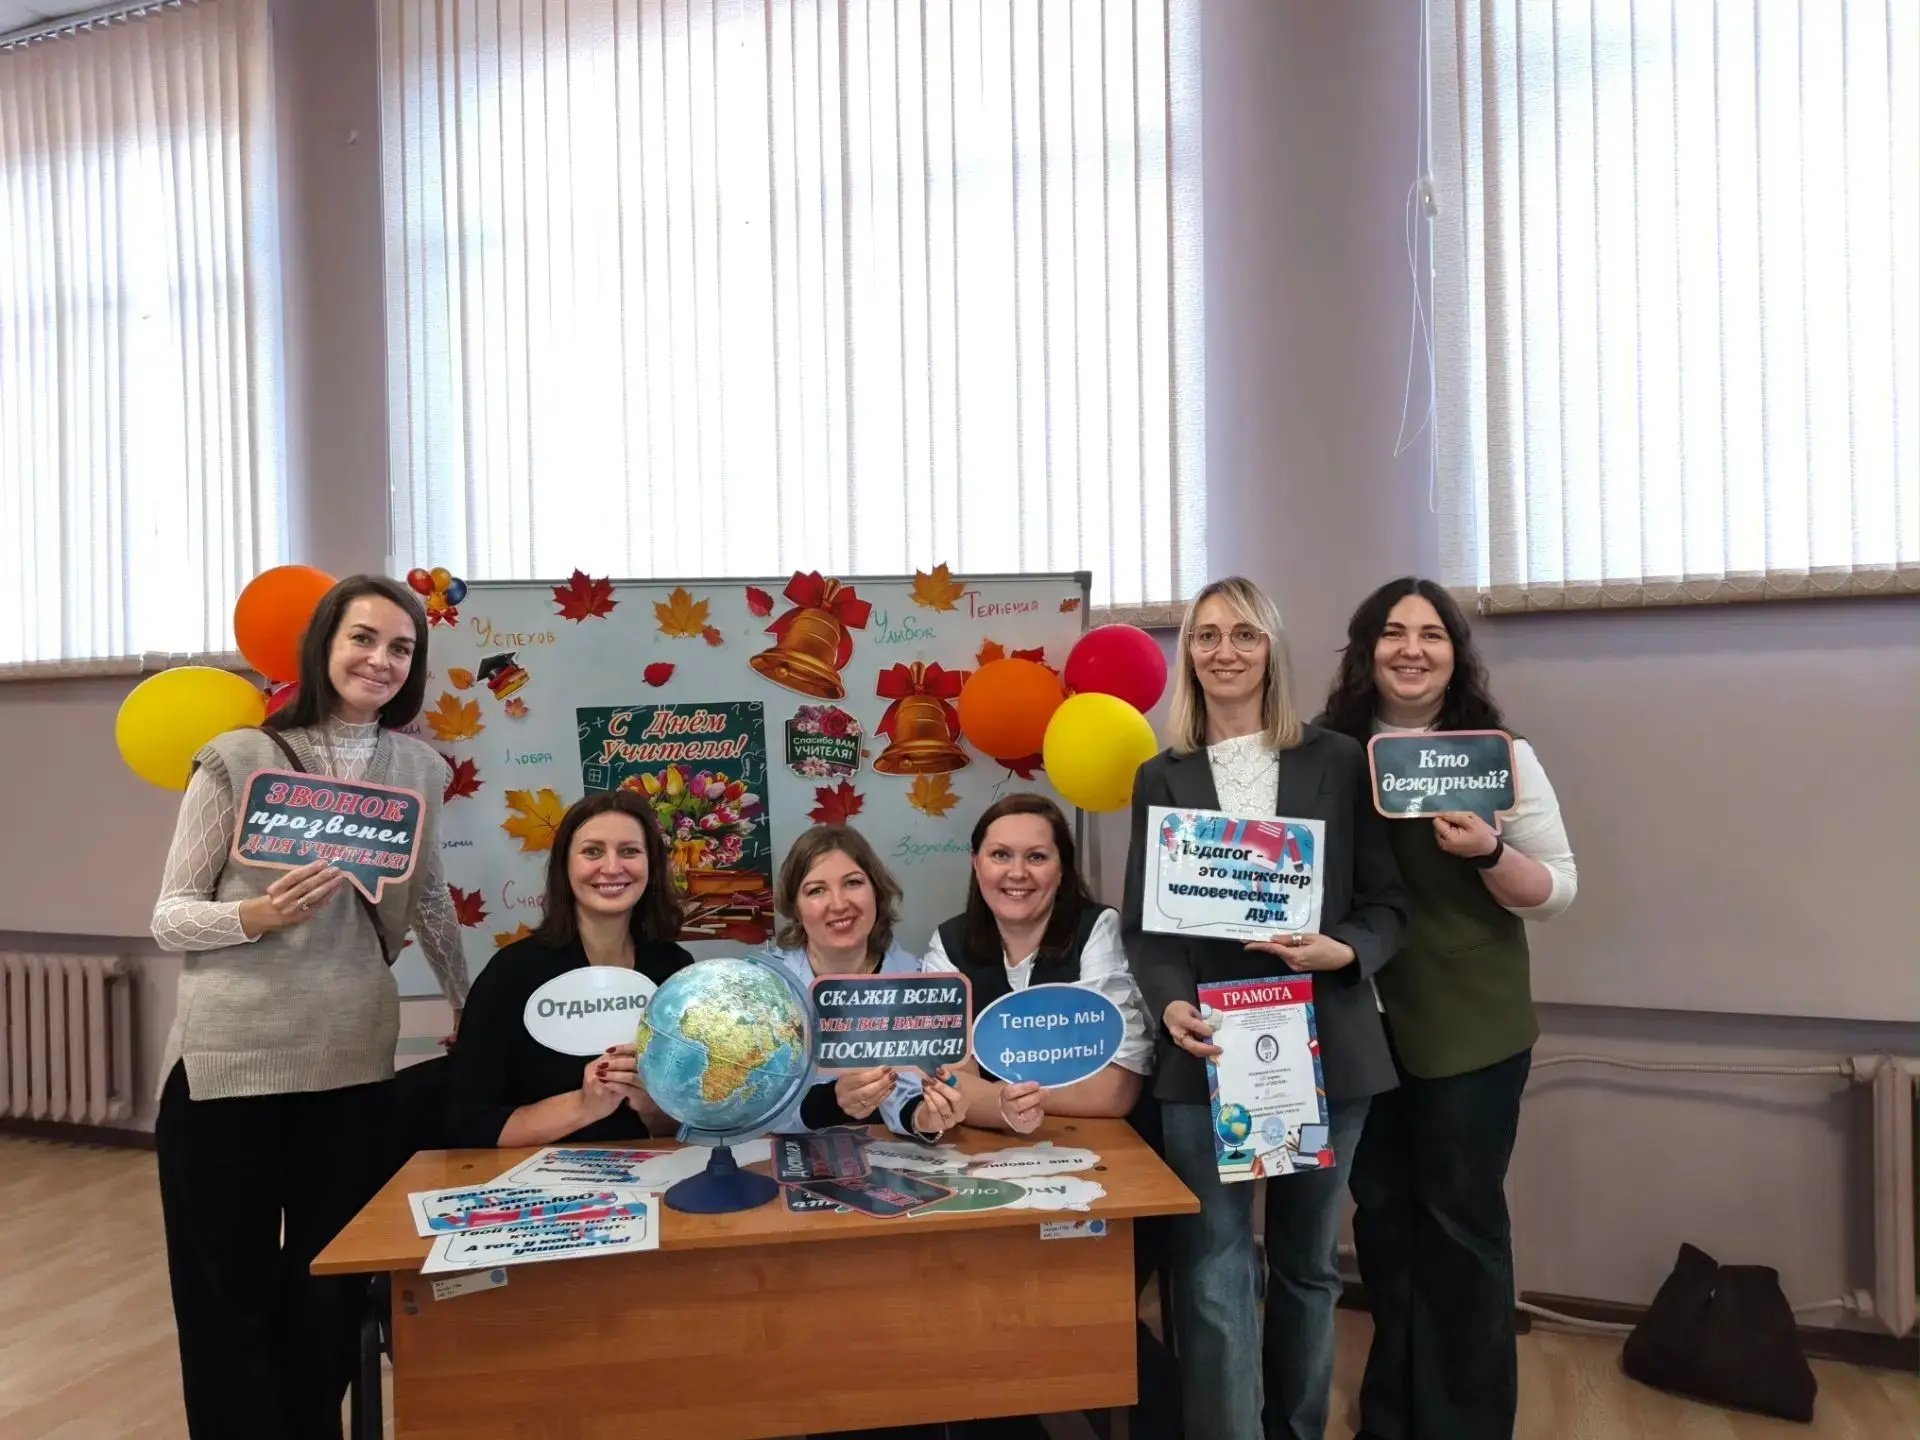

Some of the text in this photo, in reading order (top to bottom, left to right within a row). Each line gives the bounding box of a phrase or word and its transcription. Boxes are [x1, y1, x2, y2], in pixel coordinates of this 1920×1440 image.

[608, 709, 727, 739] С Днём
[599, 734, 748, 764] Учителя!
[793, 737, 834, 745] Спасибо
[794, 745, 853, 760] УЧИТЕЛЯ!
[1418, 749, 1470, 769] Кто
[1382, 770, 1509, 796] дежурный?
[265, 781, 409, 822] ЗВОНОК
[249, 810, 410, 845] прозвенел
[240, 833, 410, 870] ДЛЯ УЧИТЕЛЯ!
[1198, 866, 1311, 889] это инженер
[1168, 883, 1290, 905] человеческих
[1245, 908, 1288, 923] душ.
[537, 994, 648, 1019] Отдыхаю
[819, 987, 963, 1006] СКАЖИ ВСЕМ,
[1222, 986, 1293, 1006] ГРАМОТА
[818, 1014, 963, 1032] МЫ ВСЕ ВМЕСТЕ
[999, 1010, 1105, 1030] Теперь мы
[819, 1038, 963, 1060] ПОСМЕЕМСЯ!
[1000, 1040, 1105, 1068] фавориты!
[507, 1221, 581, 1233] учитель
[464, 1244, 478, 1252] А
[538, 1236, 581, 1245] кого
